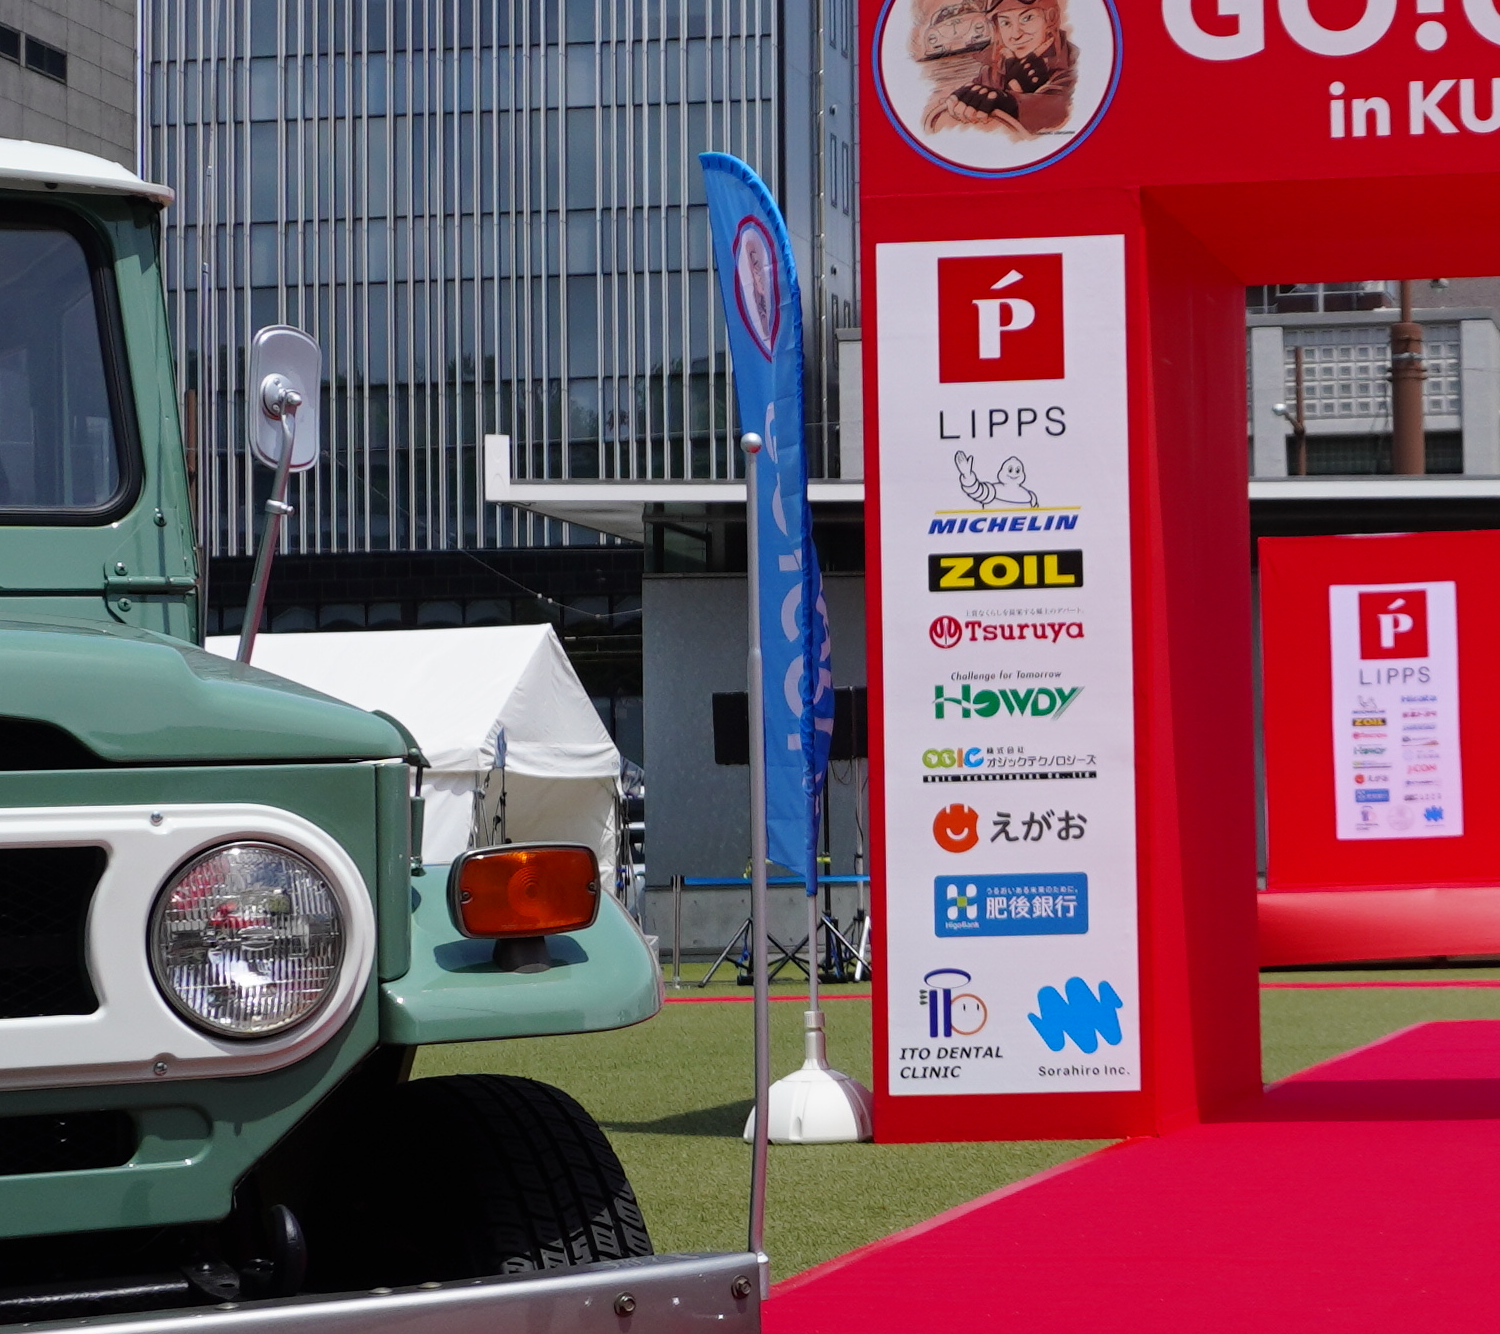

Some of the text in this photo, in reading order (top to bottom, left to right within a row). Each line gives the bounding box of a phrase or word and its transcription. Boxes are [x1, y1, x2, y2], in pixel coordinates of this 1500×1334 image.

[1328, 80, 1391, 139] in
[938, 405, 1067, 440] LIPPS
[927, 514, 1079, 535] MICHELIN
[939, 553, 1076, 589] ZOIL
[964, 620, 1085, 644] Tsuruya
[950, 669, 1062, 683] Challenge for Tomorrow
[1359, 666, 1432, 686] LIPPS
[990, 809, 1088, 843] えがお
[985, 895, 1078, 920] 肥後銀行
[899, 1045, 1004, 1060] ITO DENTAL
[899, 1065, 962, 1079] CLINIC
[1038, 1064, 1131, 1077] Sorahiro Inc.
